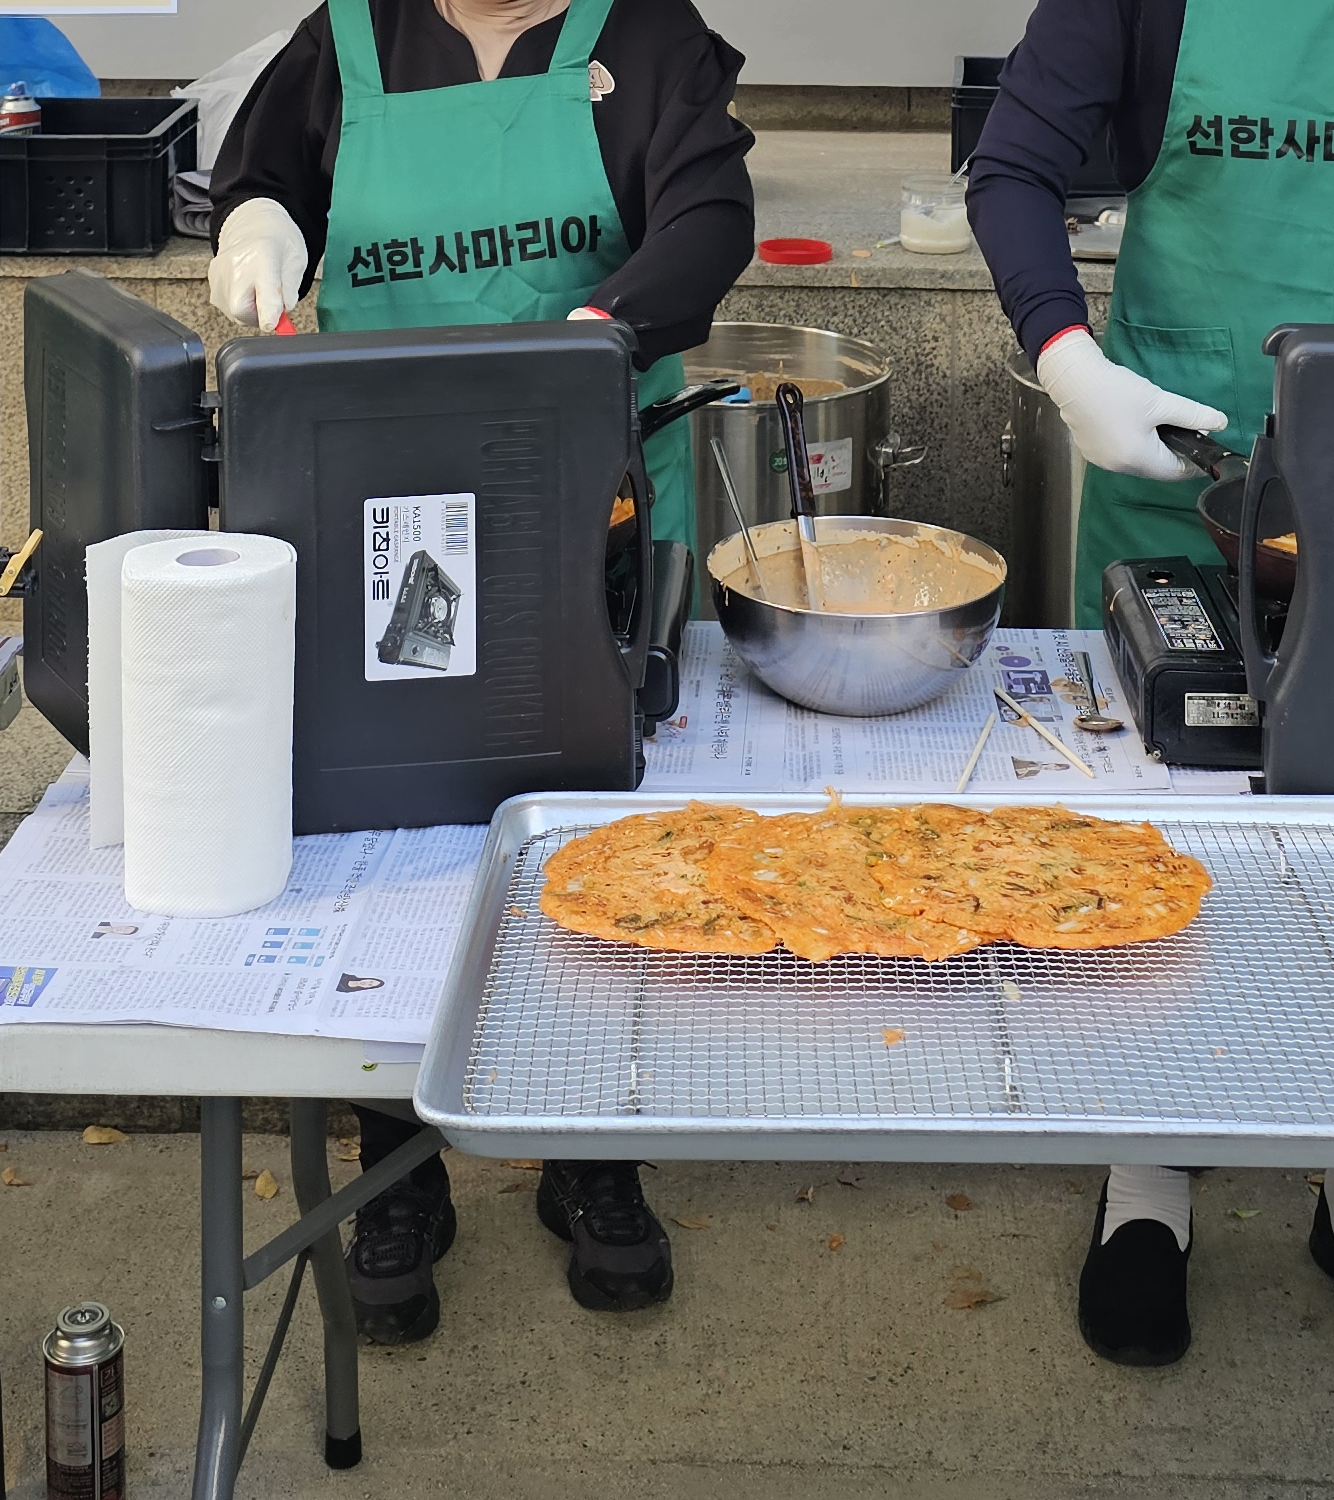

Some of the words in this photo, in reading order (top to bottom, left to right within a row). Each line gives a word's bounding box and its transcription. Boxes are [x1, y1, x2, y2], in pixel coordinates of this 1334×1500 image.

[347, 214, 602, 288] 선한사마리아
[372, 506, 392, 601] 키친아트
[412, 505, 422, 542] KA1500
